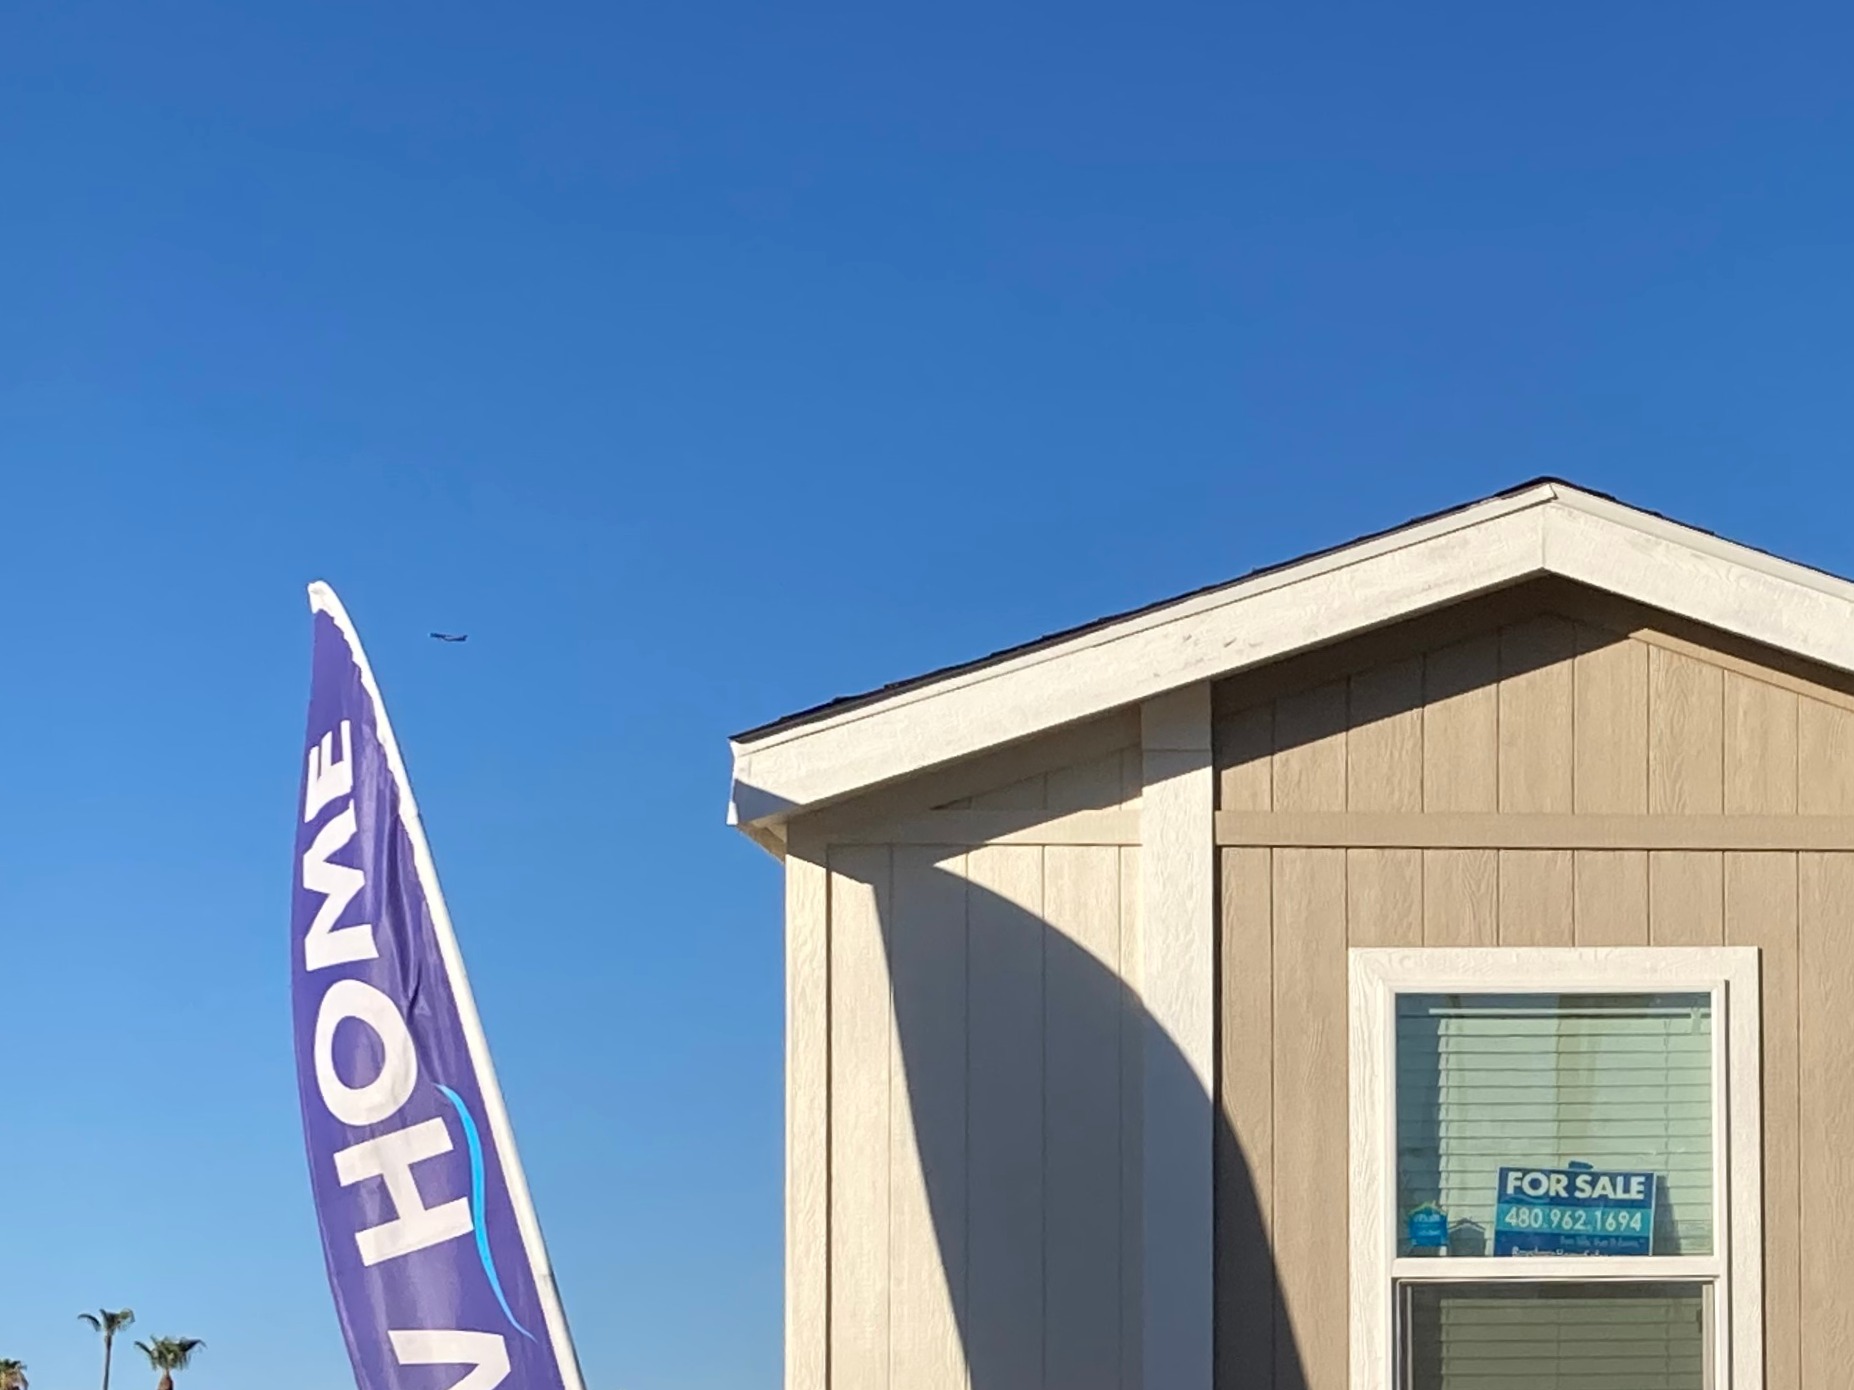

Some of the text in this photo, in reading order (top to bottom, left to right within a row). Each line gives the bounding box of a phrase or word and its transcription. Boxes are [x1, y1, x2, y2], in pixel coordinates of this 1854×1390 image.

[303, 719, 475, 1267] HOME
[1506, 1171, 1646, 1200] FOR SALE
